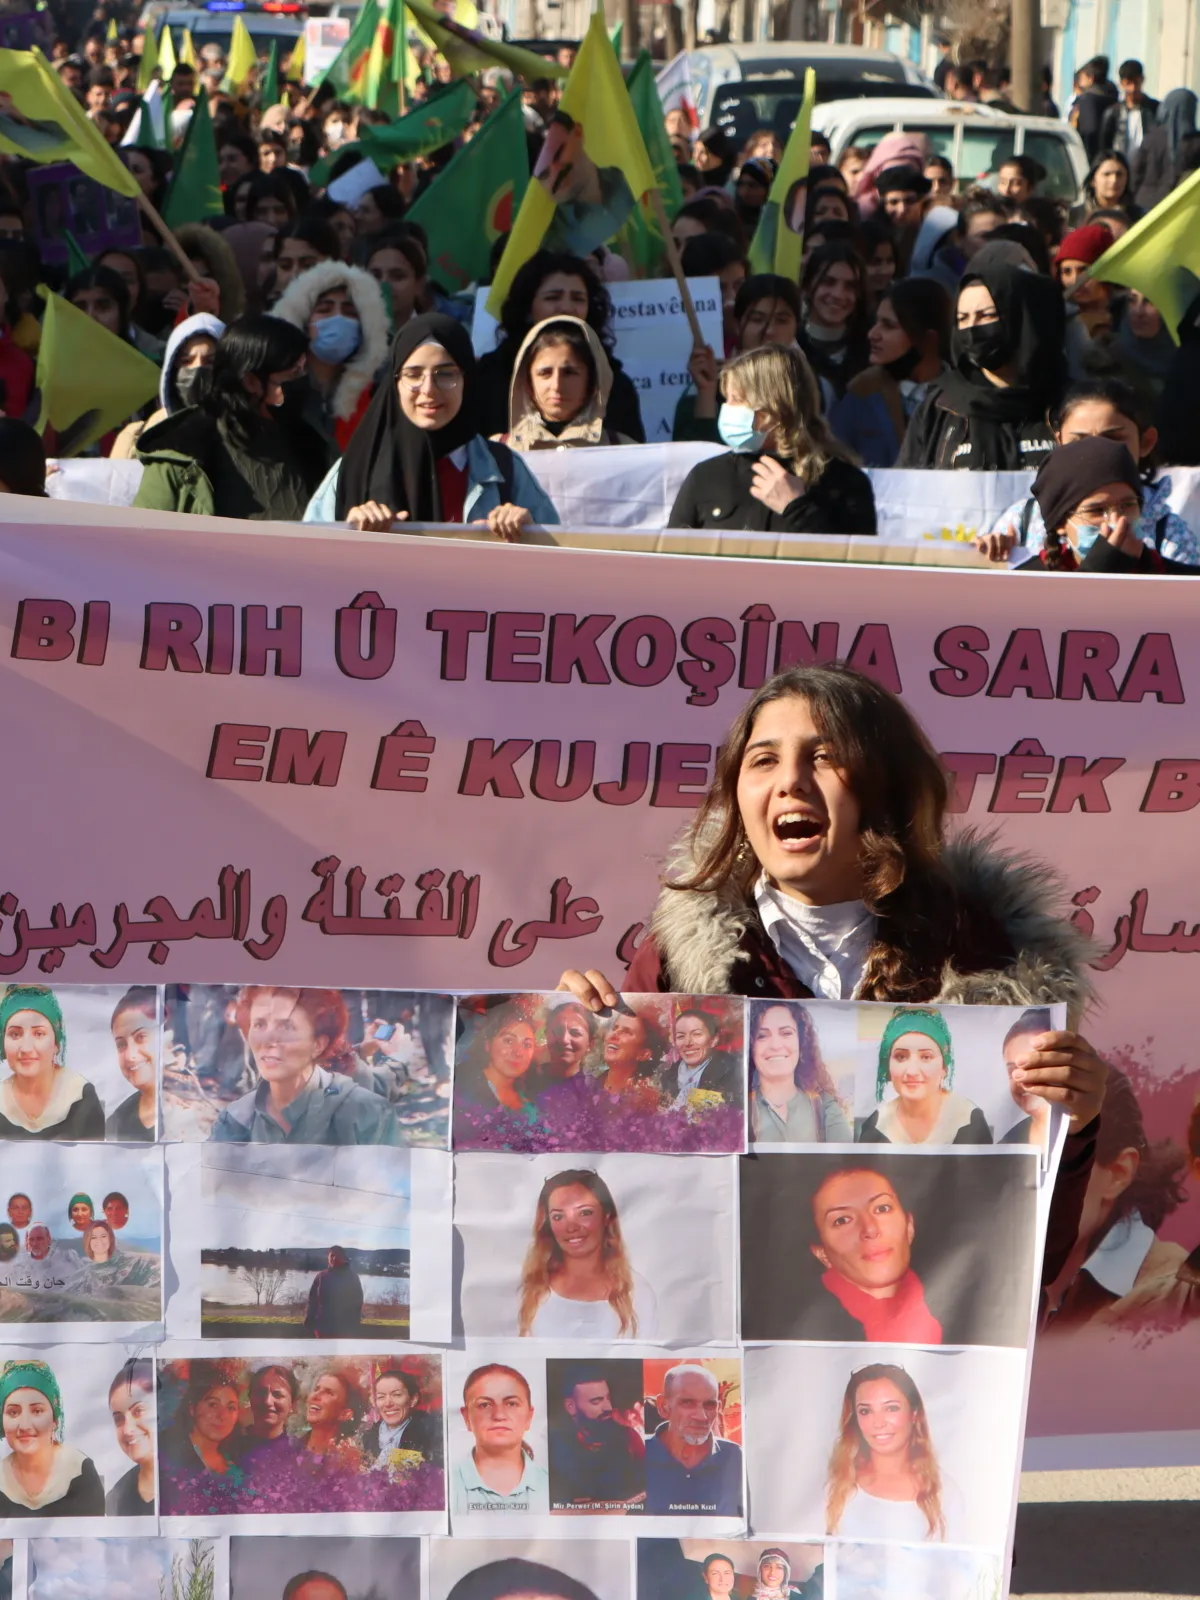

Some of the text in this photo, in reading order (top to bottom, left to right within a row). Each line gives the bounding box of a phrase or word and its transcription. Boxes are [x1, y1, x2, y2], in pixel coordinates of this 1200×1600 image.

[10, 590, 1186, 707] BI RIH Û TEKOŞÎNA SARA
[205, 722, 348, 788] EM
[370, 719, 437, 793] Ê
[457, 738, 724, 809] KUJE
[301, 854, 482, 940] القتلة
[487, 876, 604, 969] على
